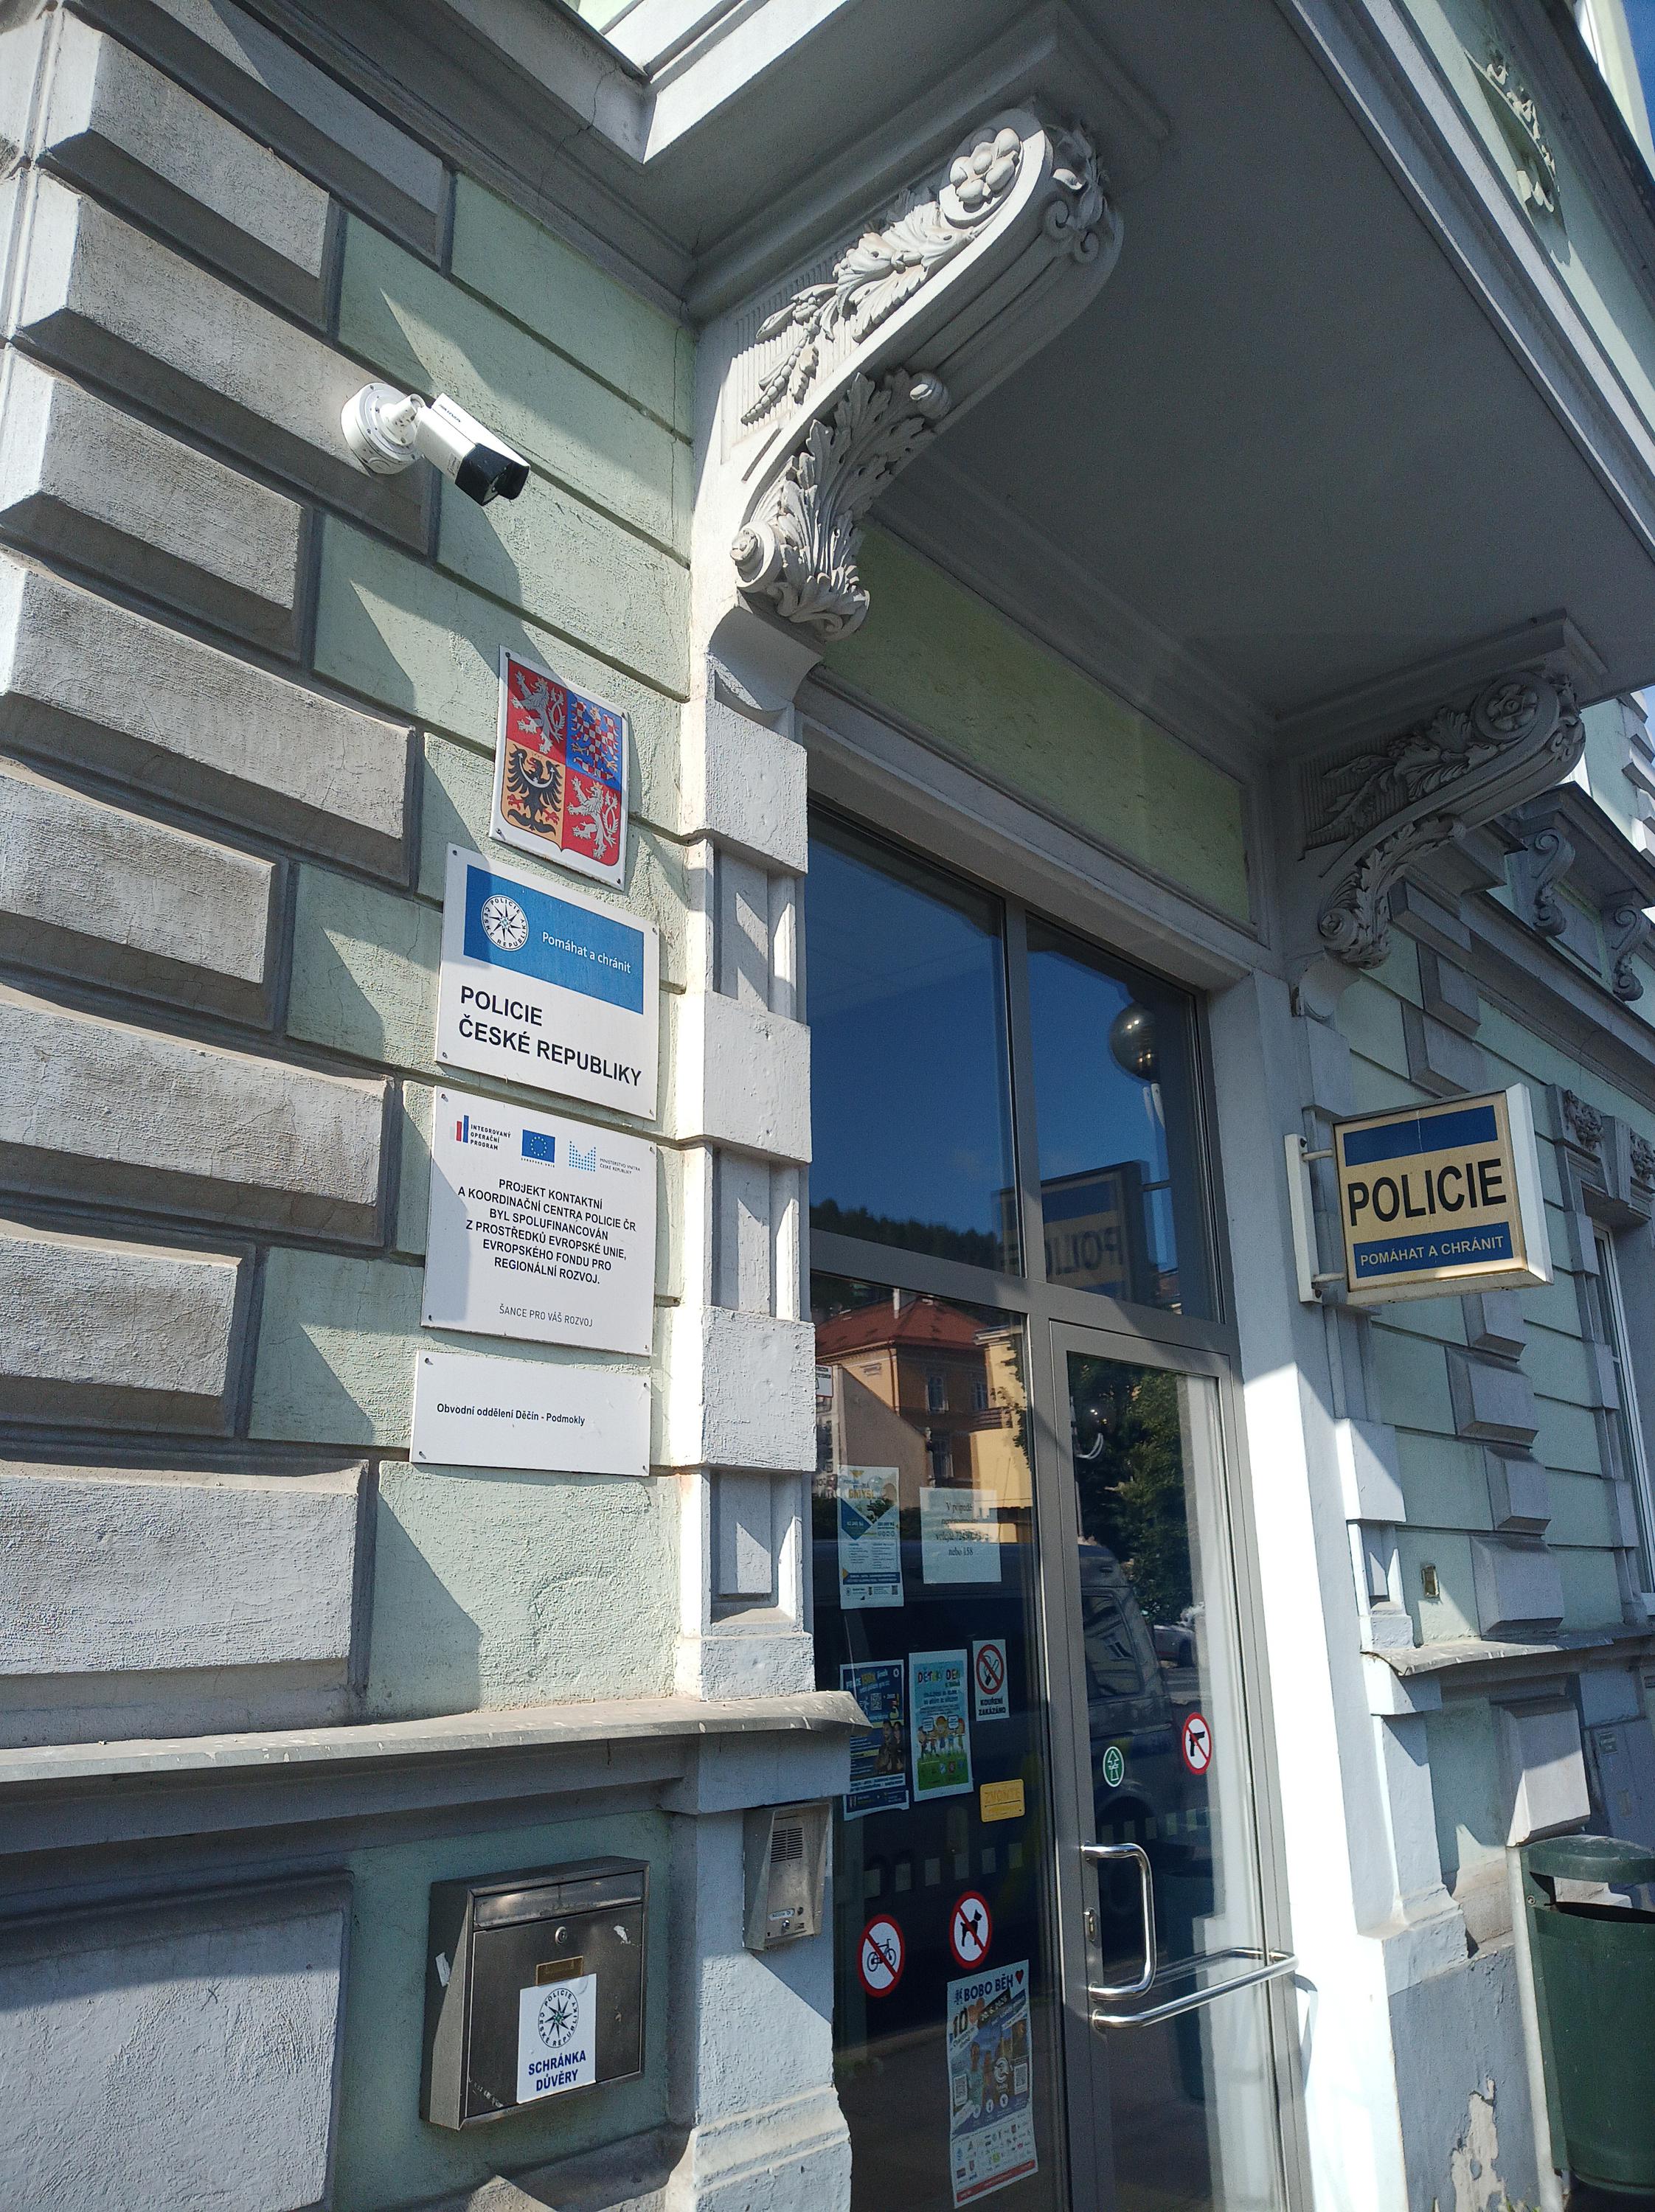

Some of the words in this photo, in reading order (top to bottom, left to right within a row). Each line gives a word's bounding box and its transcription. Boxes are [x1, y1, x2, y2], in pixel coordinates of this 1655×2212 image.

[490, 897, 521, 914] POLICIE
[496, 919, 527, 947] REPUBLIKY
[542, 931, 588, 957] Pomáhat
[589, 949, 595, 960] a
[597, 952, 631, 974] chránit
[461, 985, 542, 1026] POLICIE
[459, 1013, 530, 1054] ČESKÉ
[537, 1040, 642, 1086] REPUBLIKY
[470, 1132, 500, 1143] OPERAČNÍ
[470, 1139, 498, 1150] PROGRAM
[471, 1124, 511, 1138] INTEGROVANÝ
[499, 1178, 546, 1197] PROJEKT
[548, 1189, 603, 1210] KONTAKTNÍ
[1347, 1158, 1507, 1226] POLICIE
[458, 1186, 465, 1196] A
[468, 1188, 541, 1211] KOORDINAČNÍ
[543, 1203, 583, 1220] CENTRA
[585, 1212, 621, 1228] POLICIE
[623, 1219, 636, 1231] ČR
[490, 1208, 510, 1221] BYL
[512, 1212, 608, 1240] SPOLUFINANCOVÁN
[466, 1220, 473, 1230] Z
[476, 1221, 546, 1244] PROSTŘEDKŮ
[549, 1235, 600, 1254] EVROPSKÉ
[603, 1246, 626, 1260] UNIE,
[1361, 1246, 1425, 1266] POMÁHAT
[1429, 1245, 1438, 1256] A
[1440, 1235, 1505, 1255] CHRÁNIT
[483, 1239, 553, 1260] EVROPSKÉHO
[556, 1252, 589, 1267] FONDU
[591, 1259, 611, 1271] PRO
[494, 1256, 557, 1277] REGIONÁLNÍ
[559, 1268, 600, 1284] ROZVOJ.
[499, 1303, 527, 1318] ŠANCE
[529, 1310, 545, 1321] PRO
[548, 1311, 562, 1323] VÁŠ
[564, 1315, 593, 1327] ROZVOJ
[437, 1403, 474, 1416] Obvodní
[476, 1407, 513, 1419] oddělení
[516, 1410, 539, 1421] Děčín
[546, 1413, 586, 1427] Podmokly
[544, 1989, 572, 2007] POLICIE
[964, 1981, 993, 2002] BOBO
[995, 1973, 1013, 1992] BĚH
[552, 2002, 577, 2046] REPUBLIKY
[528, 2049, 586, 2076] SCHRÁNKA
[536, 2069, 579, 2092] DŮVĚRY
